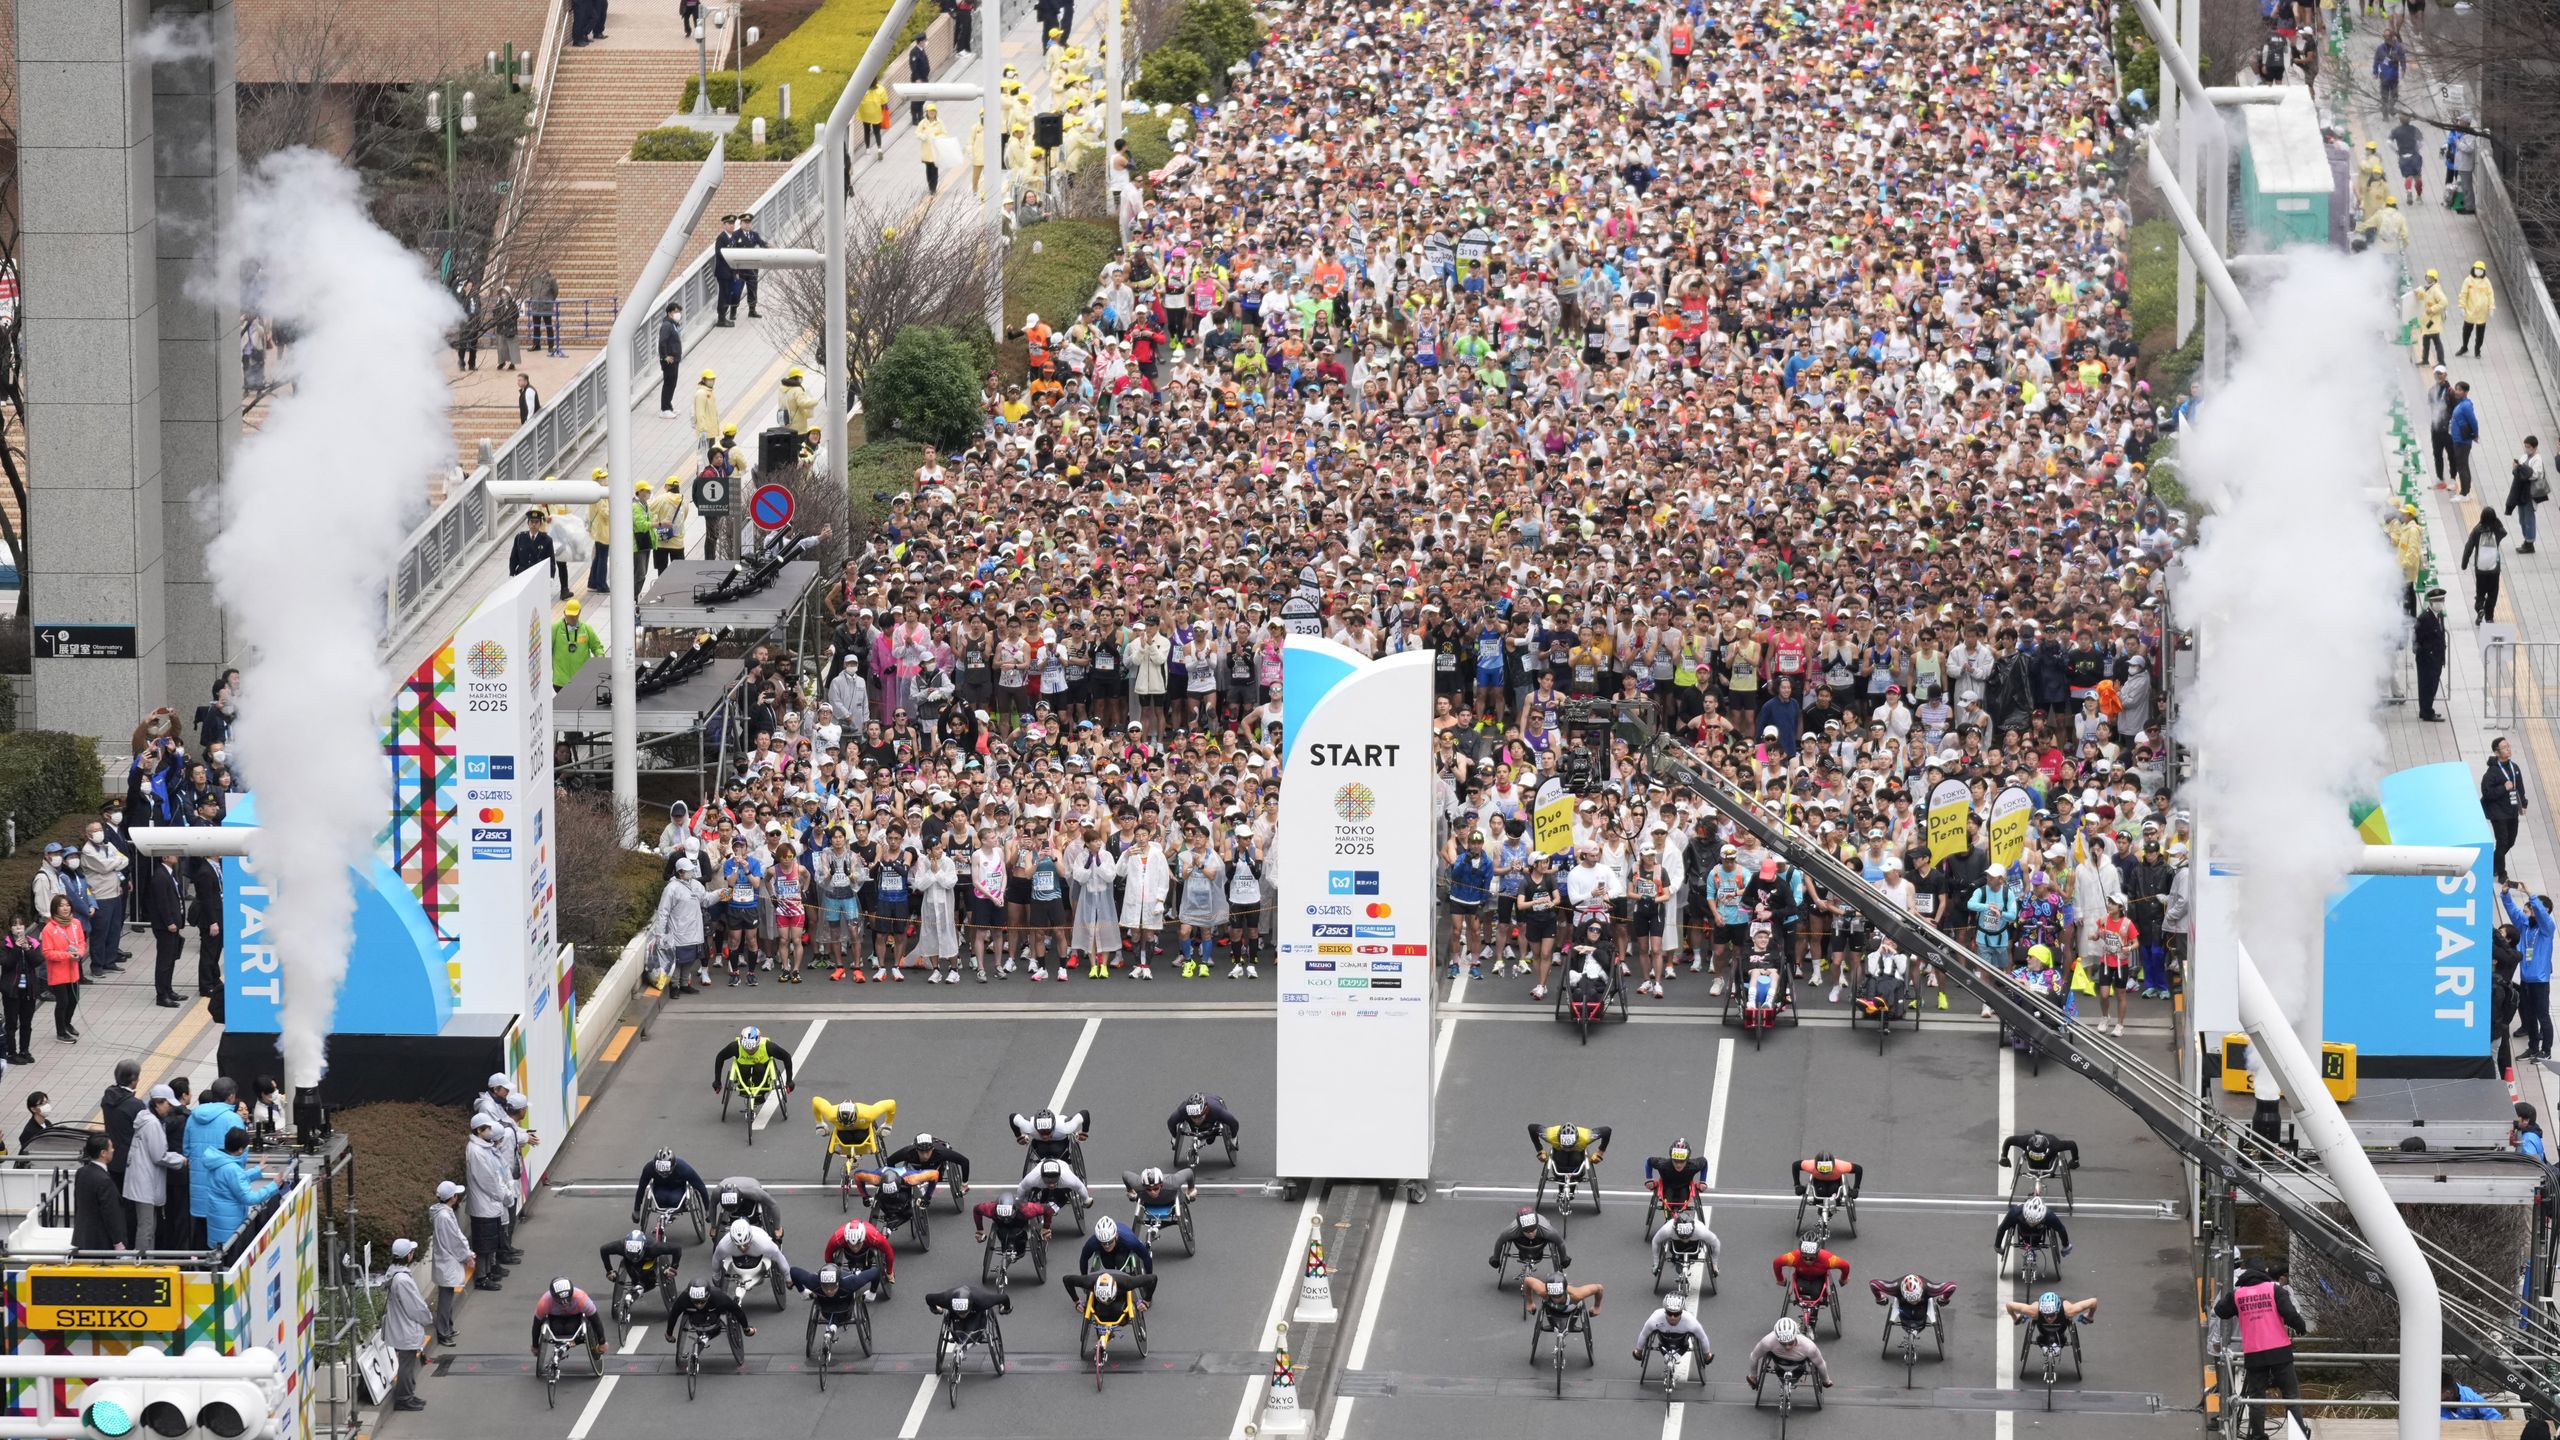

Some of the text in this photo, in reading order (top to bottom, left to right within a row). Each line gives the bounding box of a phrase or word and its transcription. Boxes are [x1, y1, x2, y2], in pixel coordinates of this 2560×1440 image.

[1295, 625, 1320, 635] 2:50
[59, 643, 91, 655] 展望室
[469, 683, 508, 692] TOKYO
[469, 700, 508, 712] 2025
[1310, 743, 1400, 767] START
[1942, 788, 1966, 800] TOKYO
[2003, 796, 2027, 809] TOKYO
[1536, 809, 1562, 829] Duo
[1930, 813, 1957, 830] Duo
[485, 830, 507, 840] asics
[1334, 825, 1375, 835] TOKYO
[1538, 823, 1570, 843] Team
[1931, 826, 1964, 844] Team
[1992, 821, 2018, 842] Duo
[1335, 843, 1375, 855] 2025
[1994, 835, 2024, 855] Team
[1326, 926, 1349, 936] asics
[1318, 945, 1352, 953] SEIKO
[1372, 963, 1400, 971] Salonpas
[2070, 1053, 2091, 1071] GF-8
[2327, 1054, 2342, 1076] 0
[153, 1279, 168, 1304] 3
[1302, 1285, 1328, 1295] TOKYO
[56, 1309, 148, 1328] SEIKO
[2506, 1373, 2528, 1391] GF-8
[1268, 1395, 1294, 1405] OKYO
